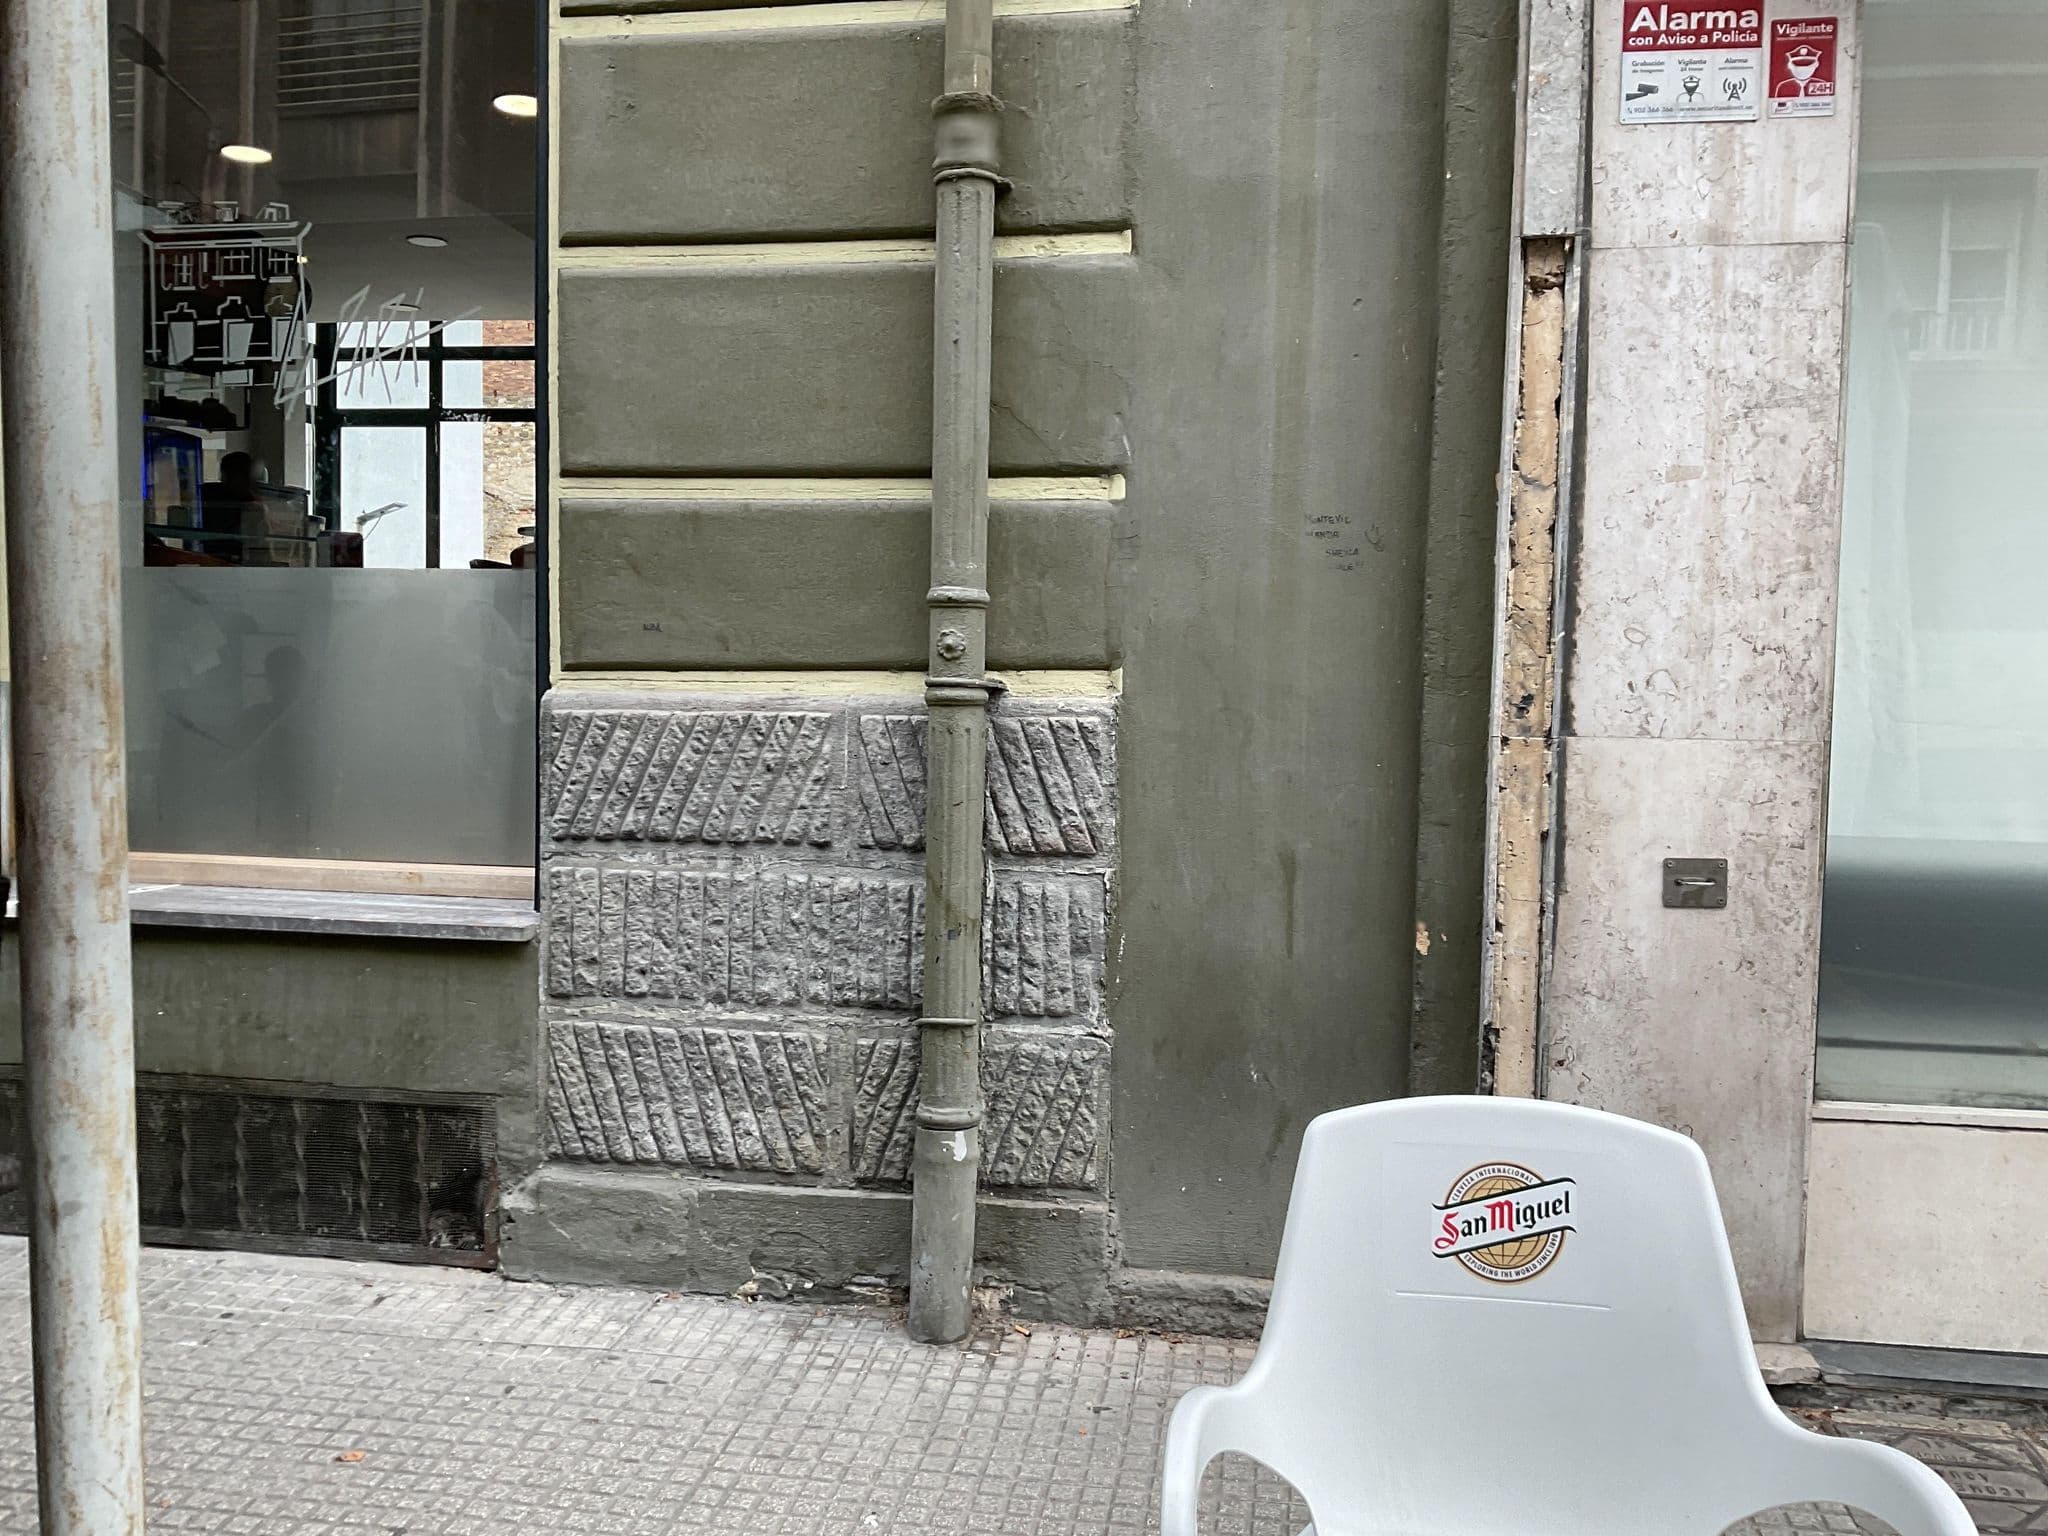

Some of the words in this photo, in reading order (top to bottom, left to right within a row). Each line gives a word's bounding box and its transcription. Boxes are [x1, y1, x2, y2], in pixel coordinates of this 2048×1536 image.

[1630, 4, 1759, 32] Alarma
[1776, 23, 1833, 36] Vigilante
[1628, 35, 1653, 46] con
[1657, 32, 1696, 45] Aviso
[1701, 35, 1708, 43] a
[1713, 30, 1758, 43] Policía
[1678, 58, 1707, 66] Vigilante
[1810, 83, 1833, 94] 24H
[1451, 1176, 1475, 1201] CERVEZA
[1475, 1167, 1534, 1184] INTERNACIONAL
[1464, 1253, 1499, 1277] EXPLORING
[1514, 1264, 1538, 1277] WORLD
[1537, 1249, 1552, 1266] SINCE
